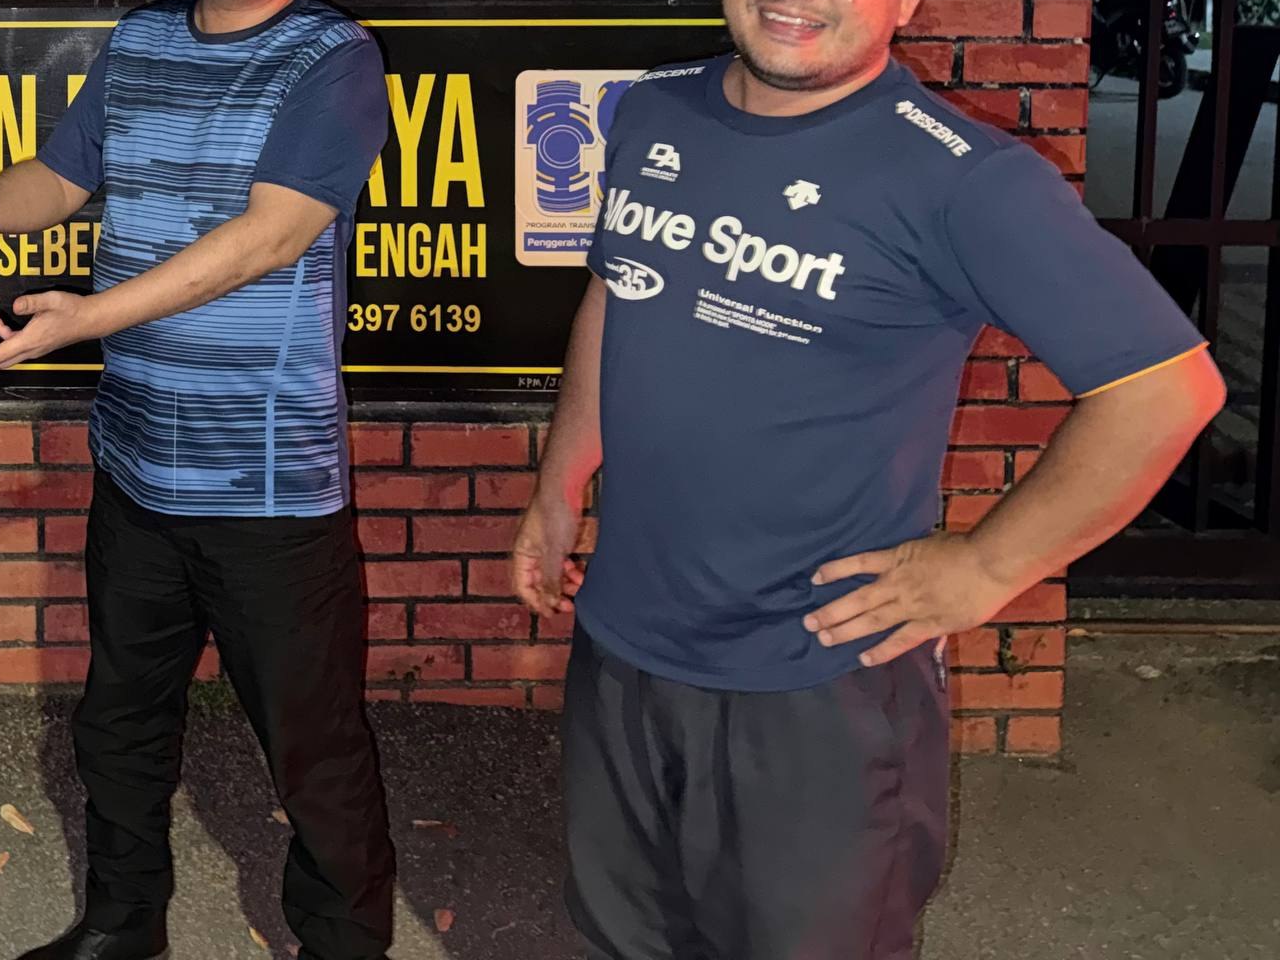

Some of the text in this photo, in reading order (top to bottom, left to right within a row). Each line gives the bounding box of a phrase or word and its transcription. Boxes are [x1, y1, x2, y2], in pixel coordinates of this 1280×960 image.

[637, 66, 706, 82] DESCENTE
[904, 108, 972, 157] DESCENTE
[356, 223, 487, 278] ENGAH
[527, 238, 593, 249] Penggerak Pe
[604, 187, 846, 300] Move Sport
[410, 304, 482, 333] 6139
[698, 288, 754, 314] Universal
[756, 308, 823, 333] Function
